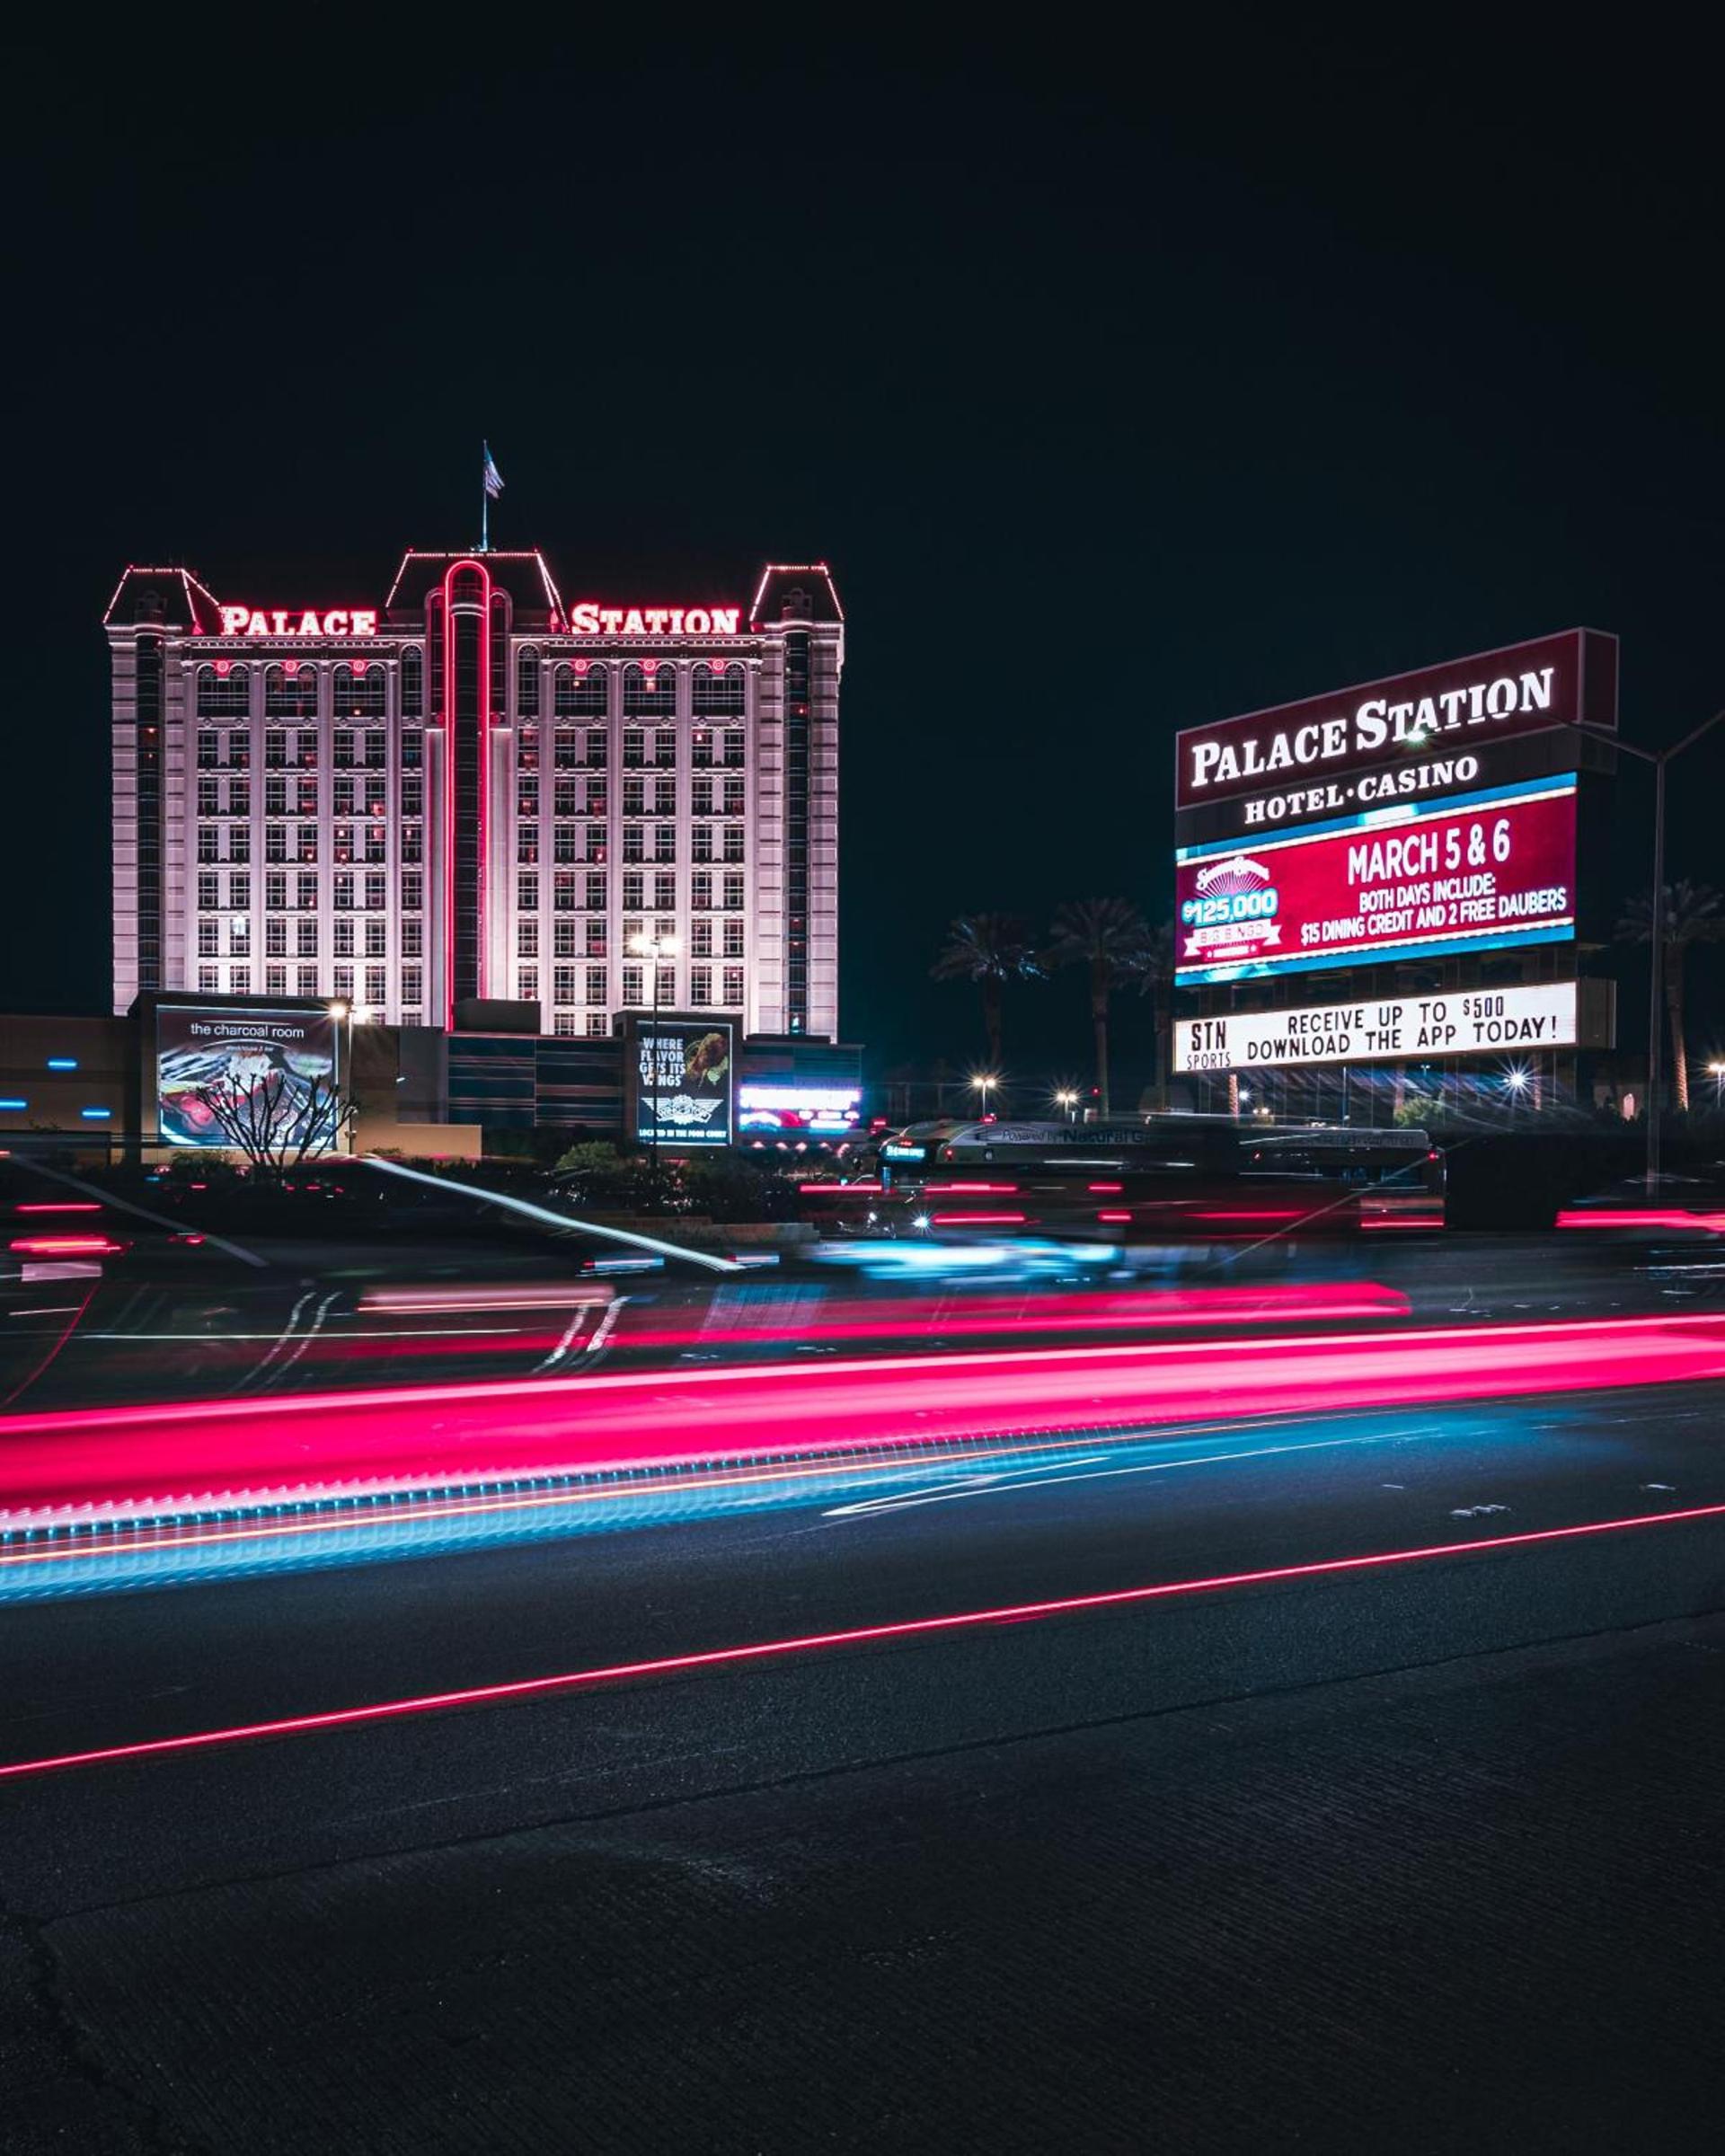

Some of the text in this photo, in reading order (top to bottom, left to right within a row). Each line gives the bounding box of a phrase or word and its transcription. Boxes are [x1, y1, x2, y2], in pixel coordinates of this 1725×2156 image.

[221, 604, 739, 636] PALACE STATION
[1191, 668, 1554, 788] PALACE STATION
[1348, 818, 1510, 886] MARCH 5 & 6
[1182, 889, 1278, 925] $125,000
[1359, 872, 1496, 914] BOTH DAYS INCLUDE:
[1225, 923, 1264, 941] BNGO
[1301, 887, 1566, 946] $15 DINING CREDIT AND 2 FREE DAUBERS
[190, 1022, 305, 1038] the charcoal room
[1288, 996, 1504, 1035] RECEIVE UP TO $500
[642, 1037, 684, 1050] WHERE
[1191, 1021, 1226, 1052] STN
[1248, 1016, 1557, 1060] DOWNLOAD THE APP TODAY!
[669, 1063, 686, 1074] ITS
[1187, 1052, 1231, 1070] SPORTS
[641, 1074, 681, 1086] WNGS
